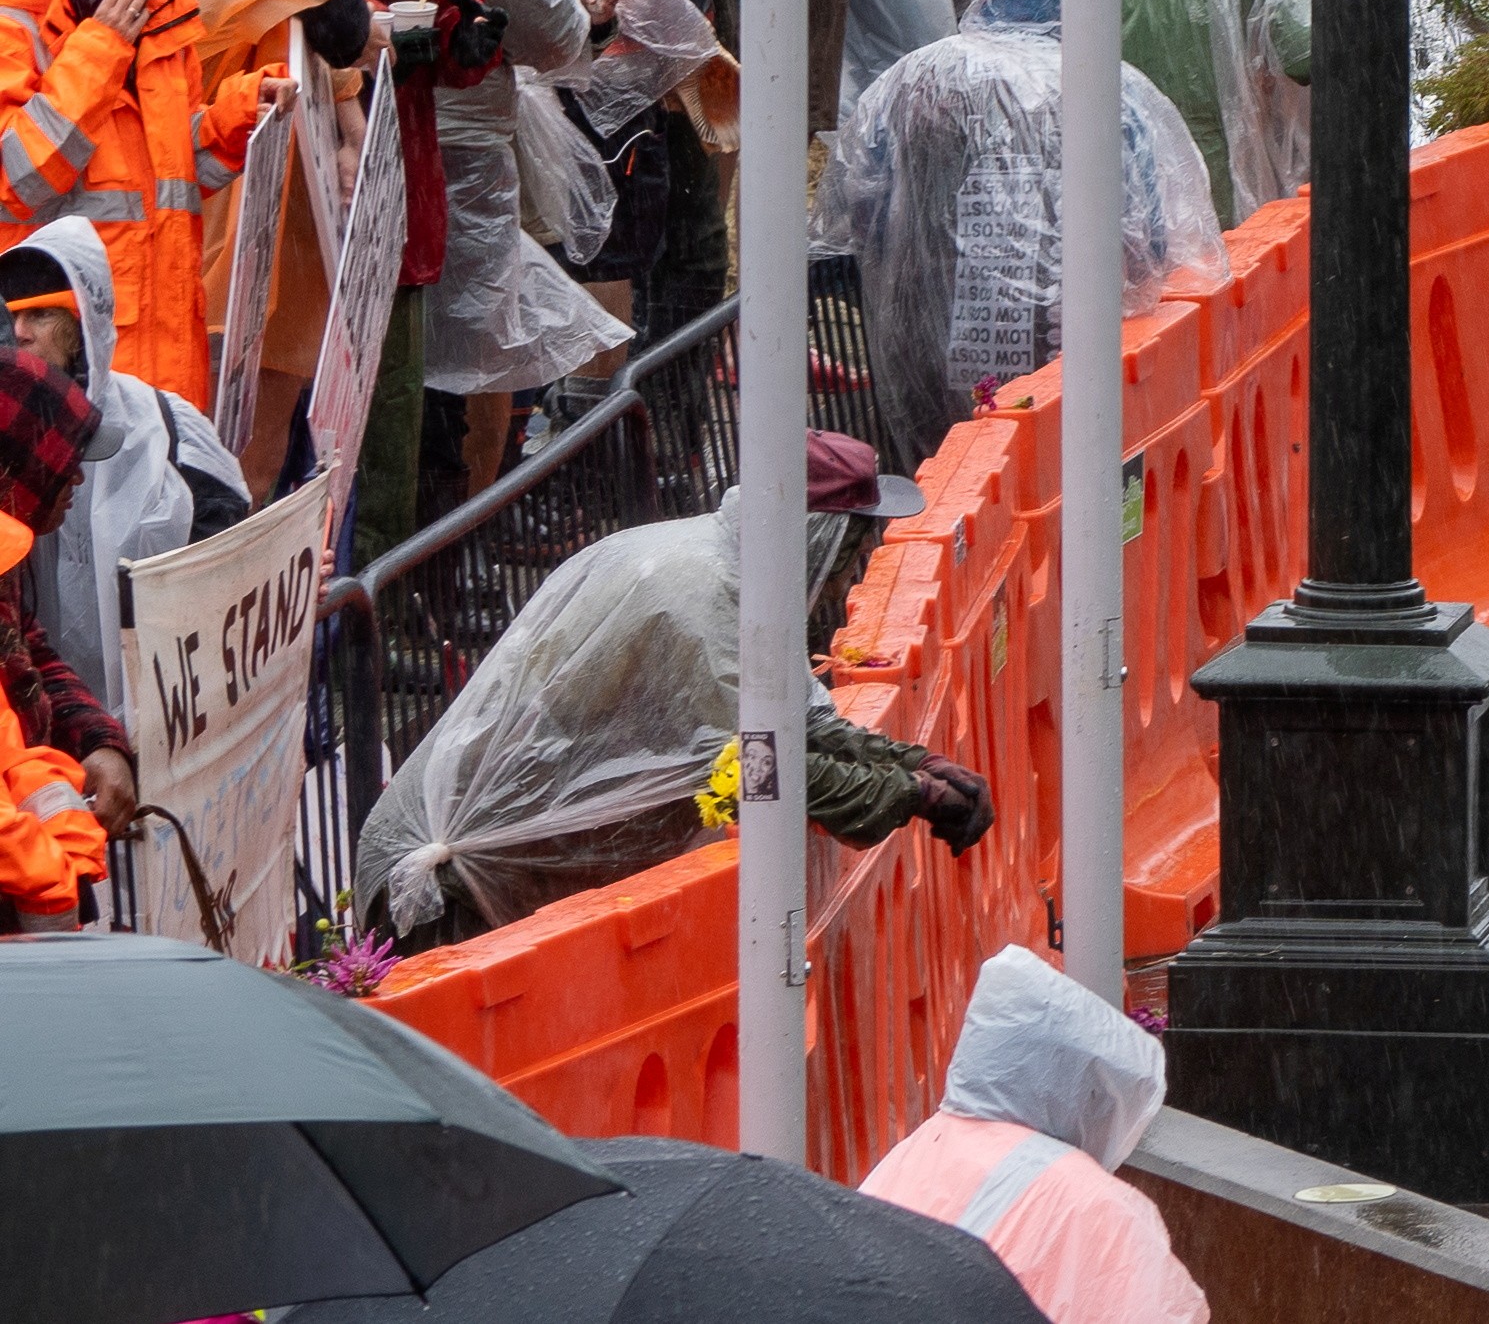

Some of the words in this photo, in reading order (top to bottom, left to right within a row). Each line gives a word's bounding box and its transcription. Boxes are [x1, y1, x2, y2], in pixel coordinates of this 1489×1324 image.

[994, 307, 1032, 323] LOW
[994, 329, 1030, 345] LOW
[949, 347, 991, 365] COST
[994, 350, 1031, 366] LOW
[153, 631, 206, 759] WE
[222, 546, 314, 707] STAND
